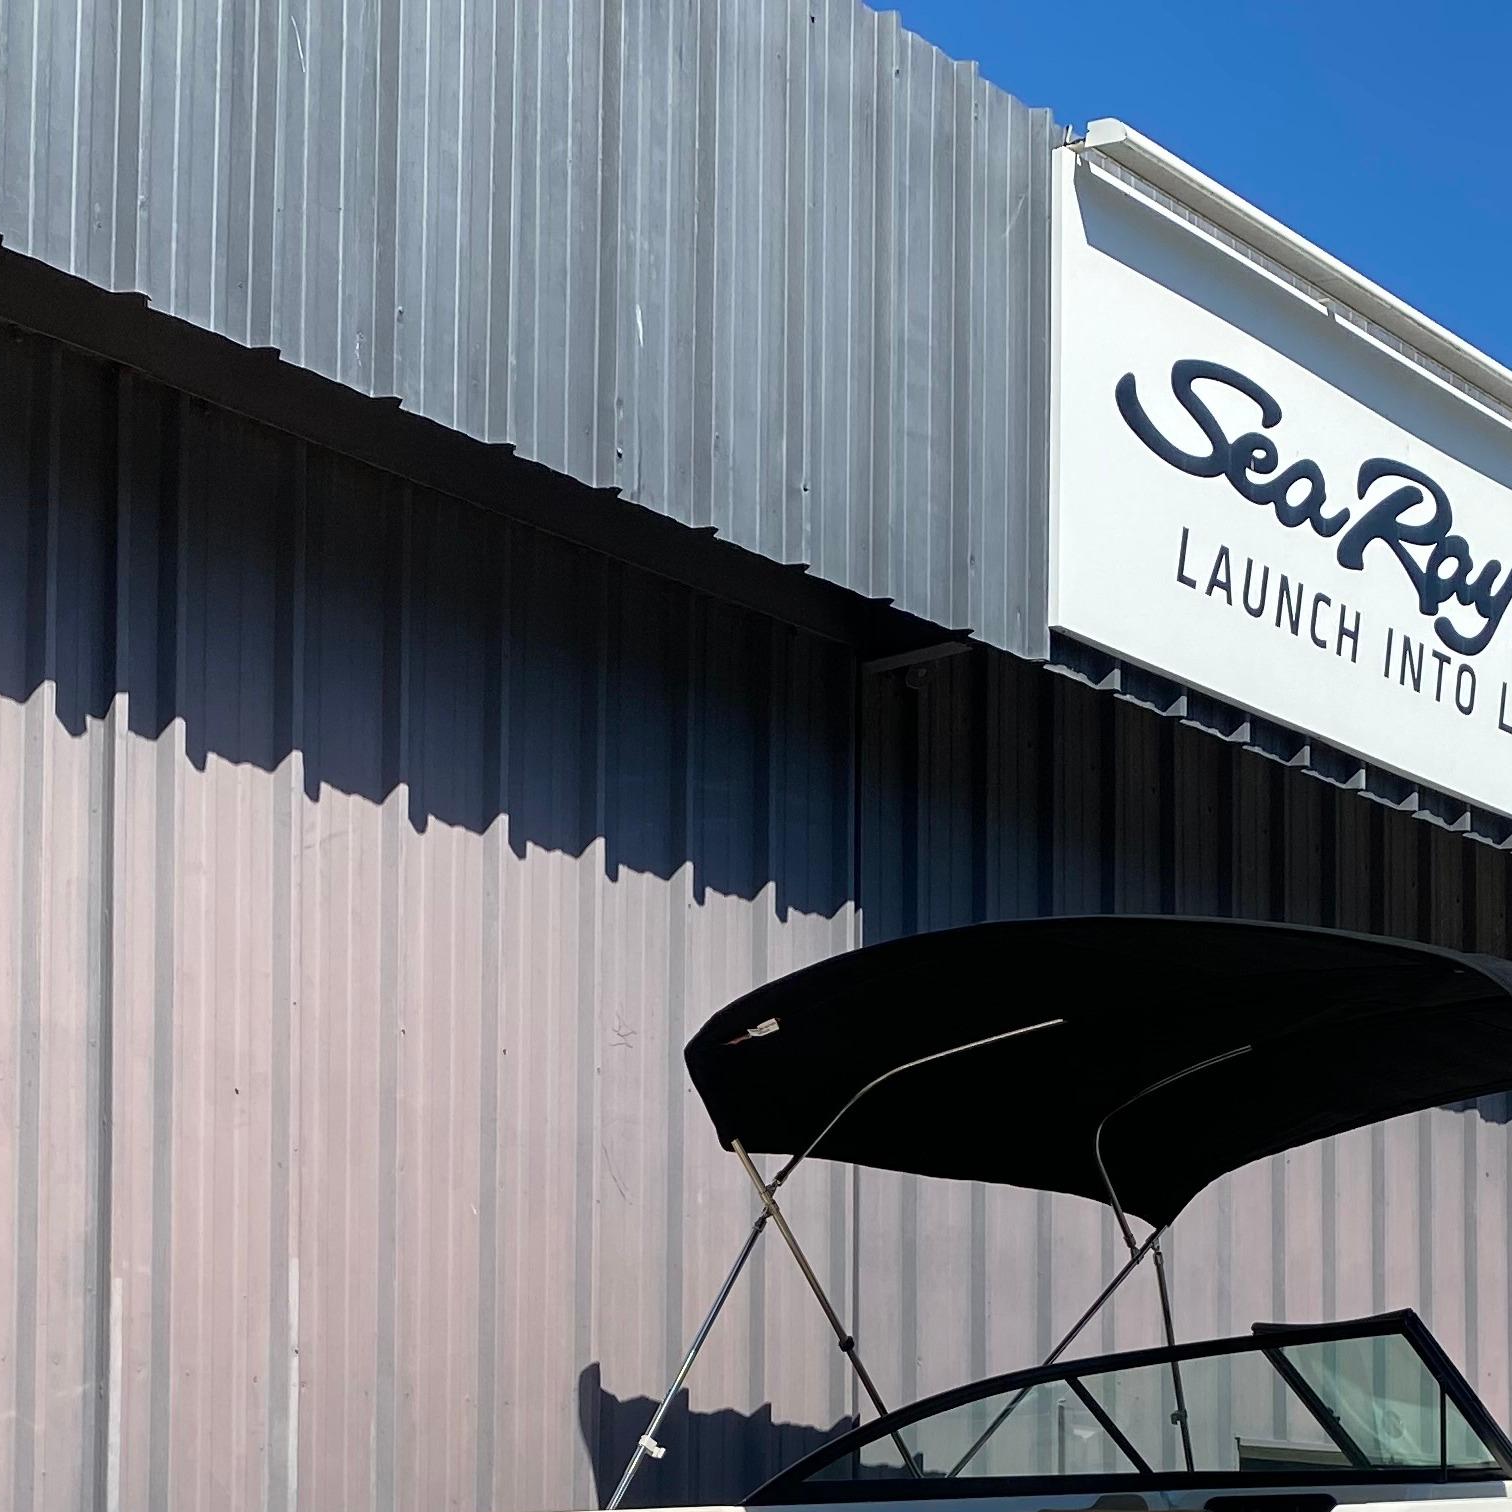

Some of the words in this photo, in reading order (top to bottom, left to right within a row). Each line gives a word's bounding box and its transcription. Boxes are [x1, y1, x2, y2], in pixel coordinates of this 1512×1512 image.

[1114, 358, 1350, 538] Sea
[1176, 526, 1360, 663] LAUNCH
[1384, 626, 1477, 717] INTO
